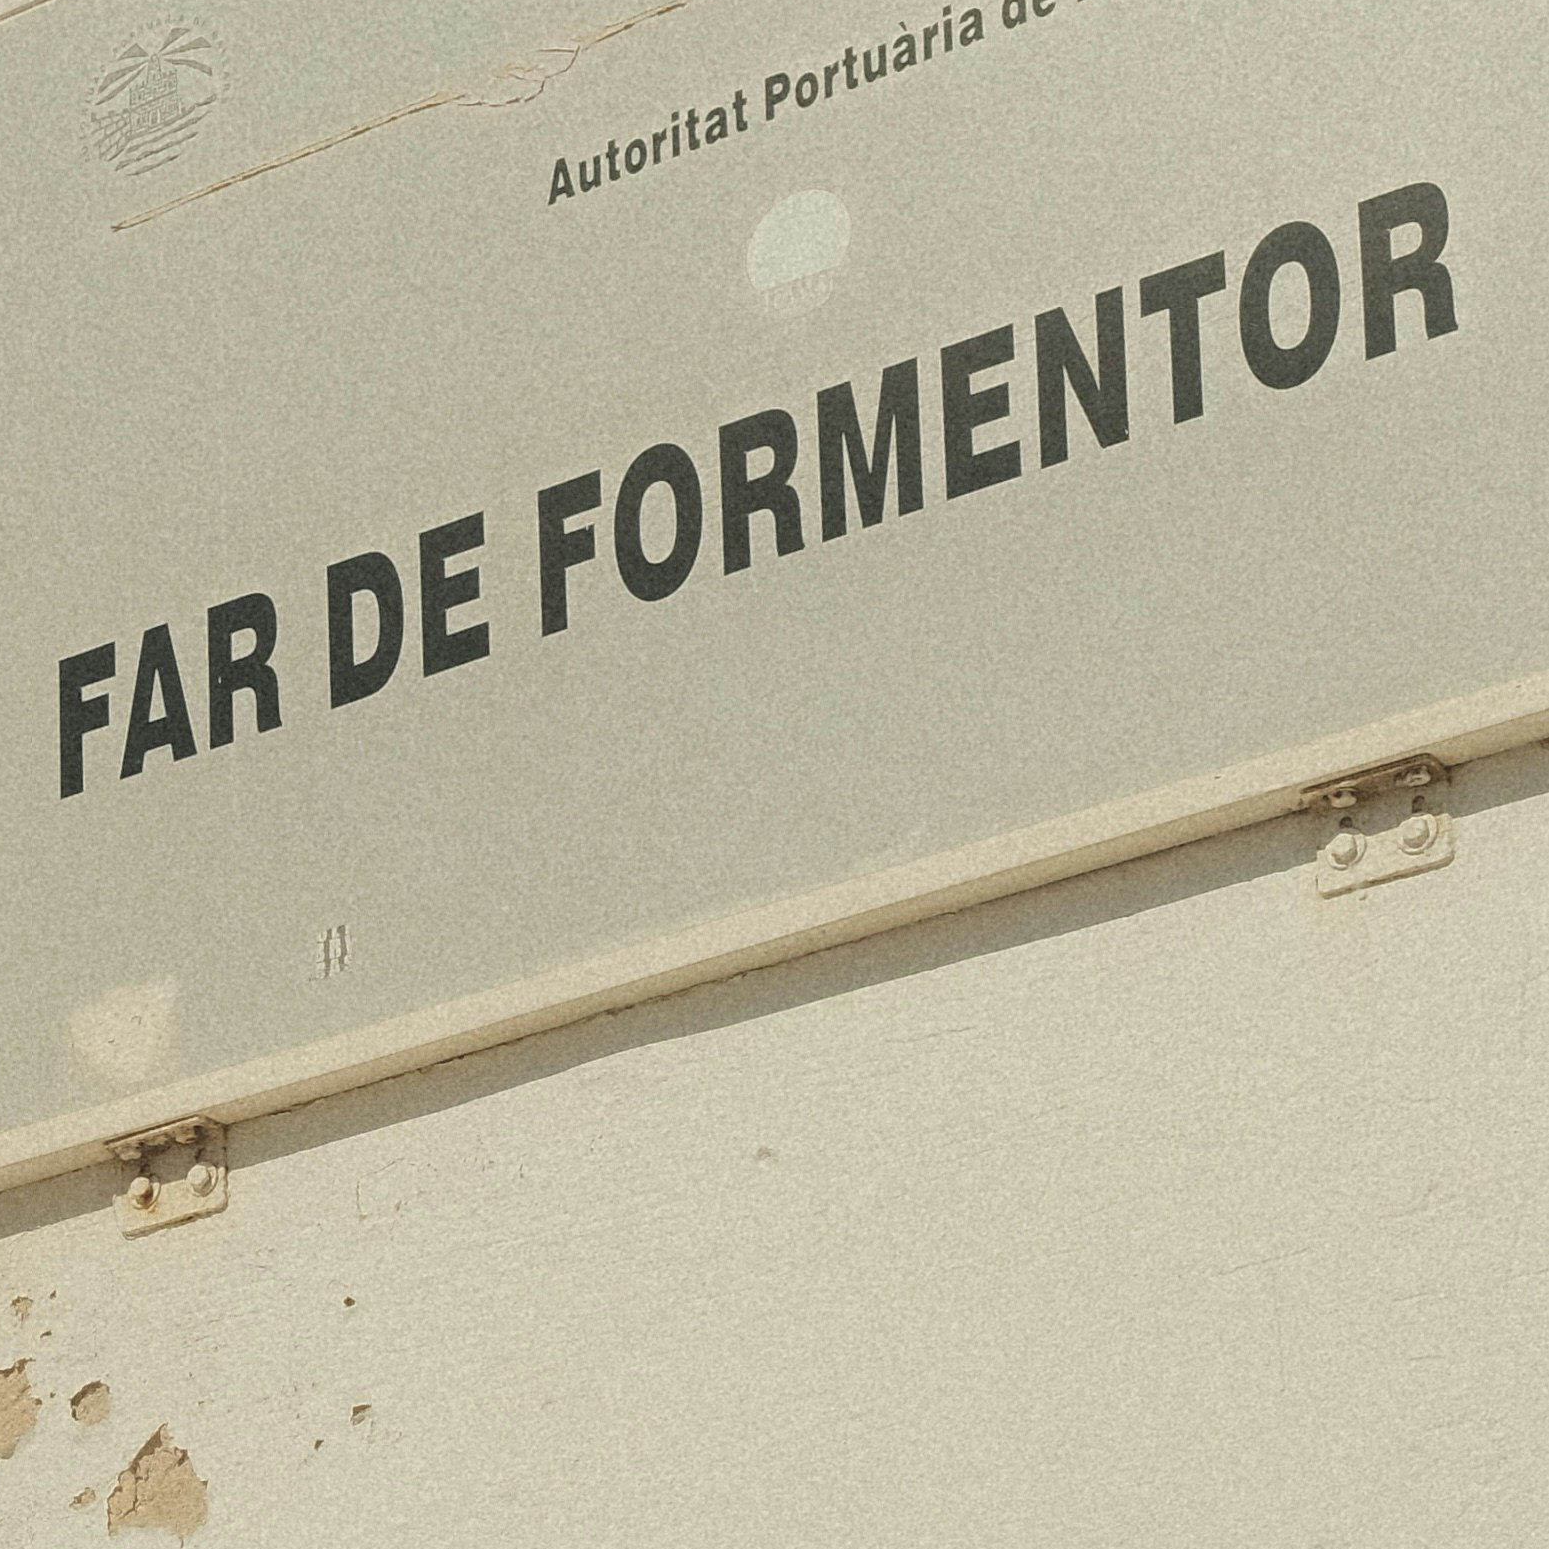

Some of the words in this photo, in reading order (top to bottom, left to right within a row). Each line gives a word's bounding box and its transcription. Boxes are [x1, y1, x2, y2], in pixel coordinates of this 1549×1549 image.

[547, 89, 749, 206] Autoritat
[764, 7, 984, 122] Portuària
[57, 592, 283, 800] FAR
[326, 511, 491, 710] DE
[537, 181, 1460, 639] FORMENTOR
